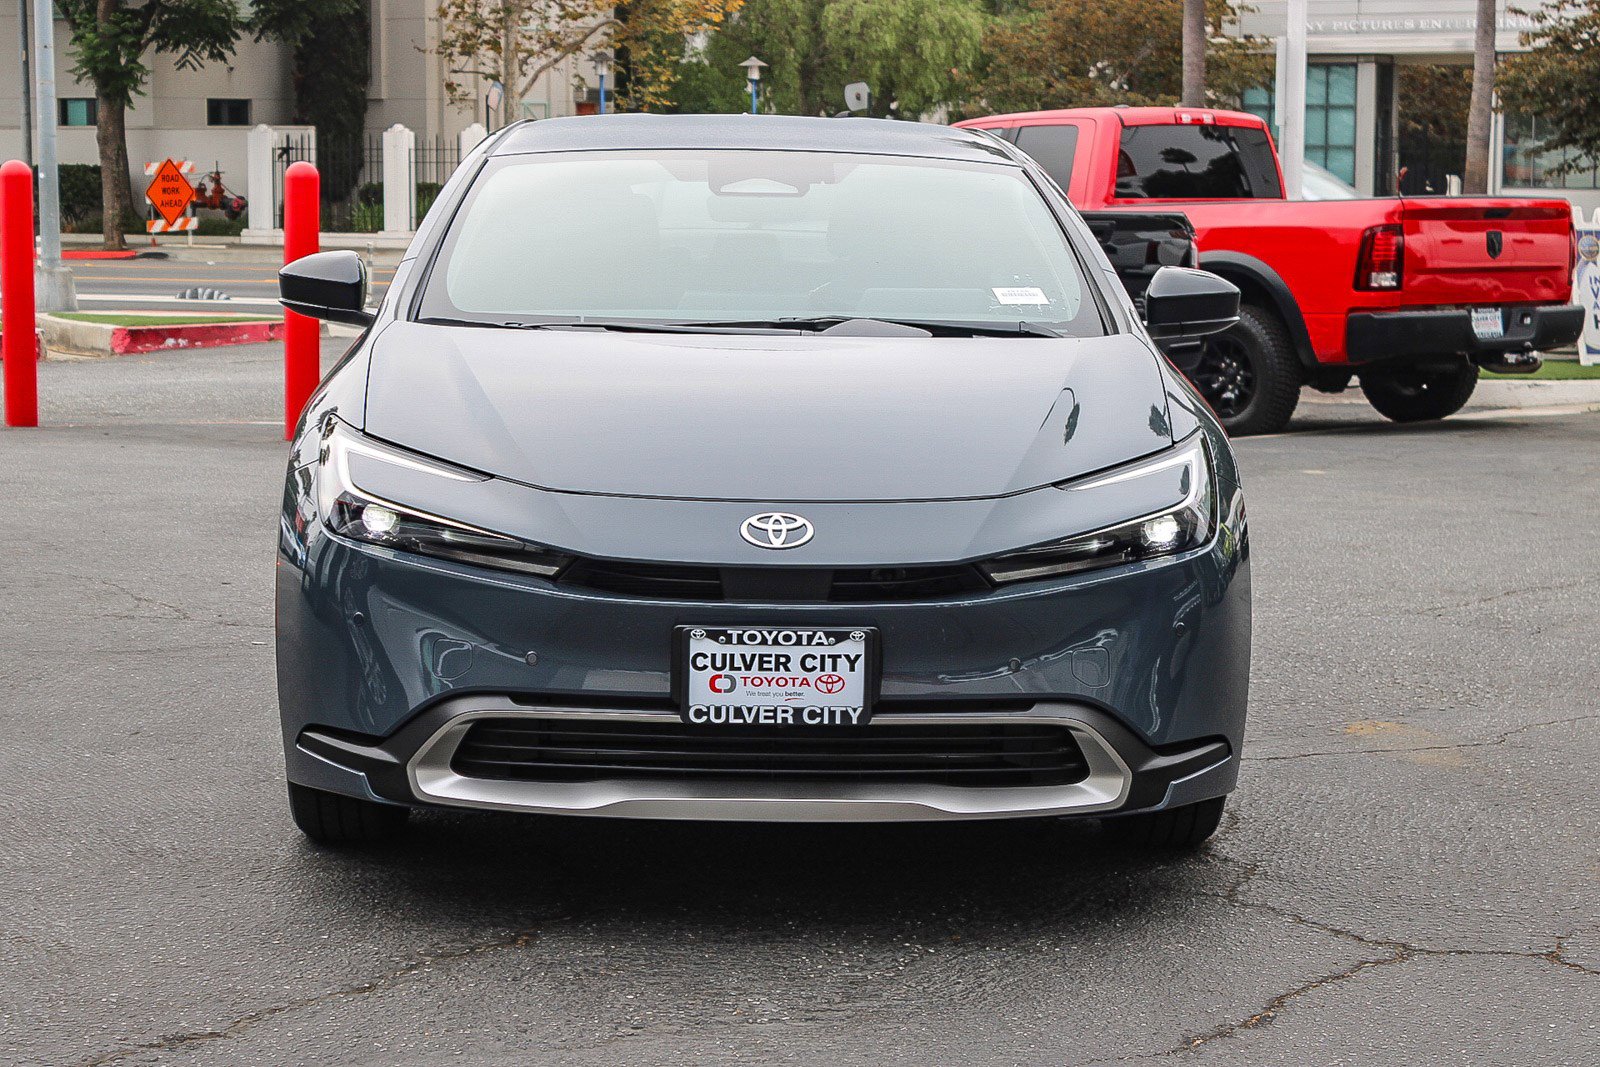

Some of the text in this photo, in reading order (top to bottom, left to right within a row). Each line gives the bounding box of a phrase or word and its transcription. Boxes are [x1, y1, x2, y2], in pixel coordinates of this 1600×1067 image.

[1333, 19, 1414, 30] PICTURES
[161, 174, 179, 183] ROAD
[727, 630, 828, 646] TOYOTA
[690, 652, 863, 672] CULVER CITY
[740, 676, 811, 688] TOYOTA
[688, 704, 864, 725] CULVER CITY
